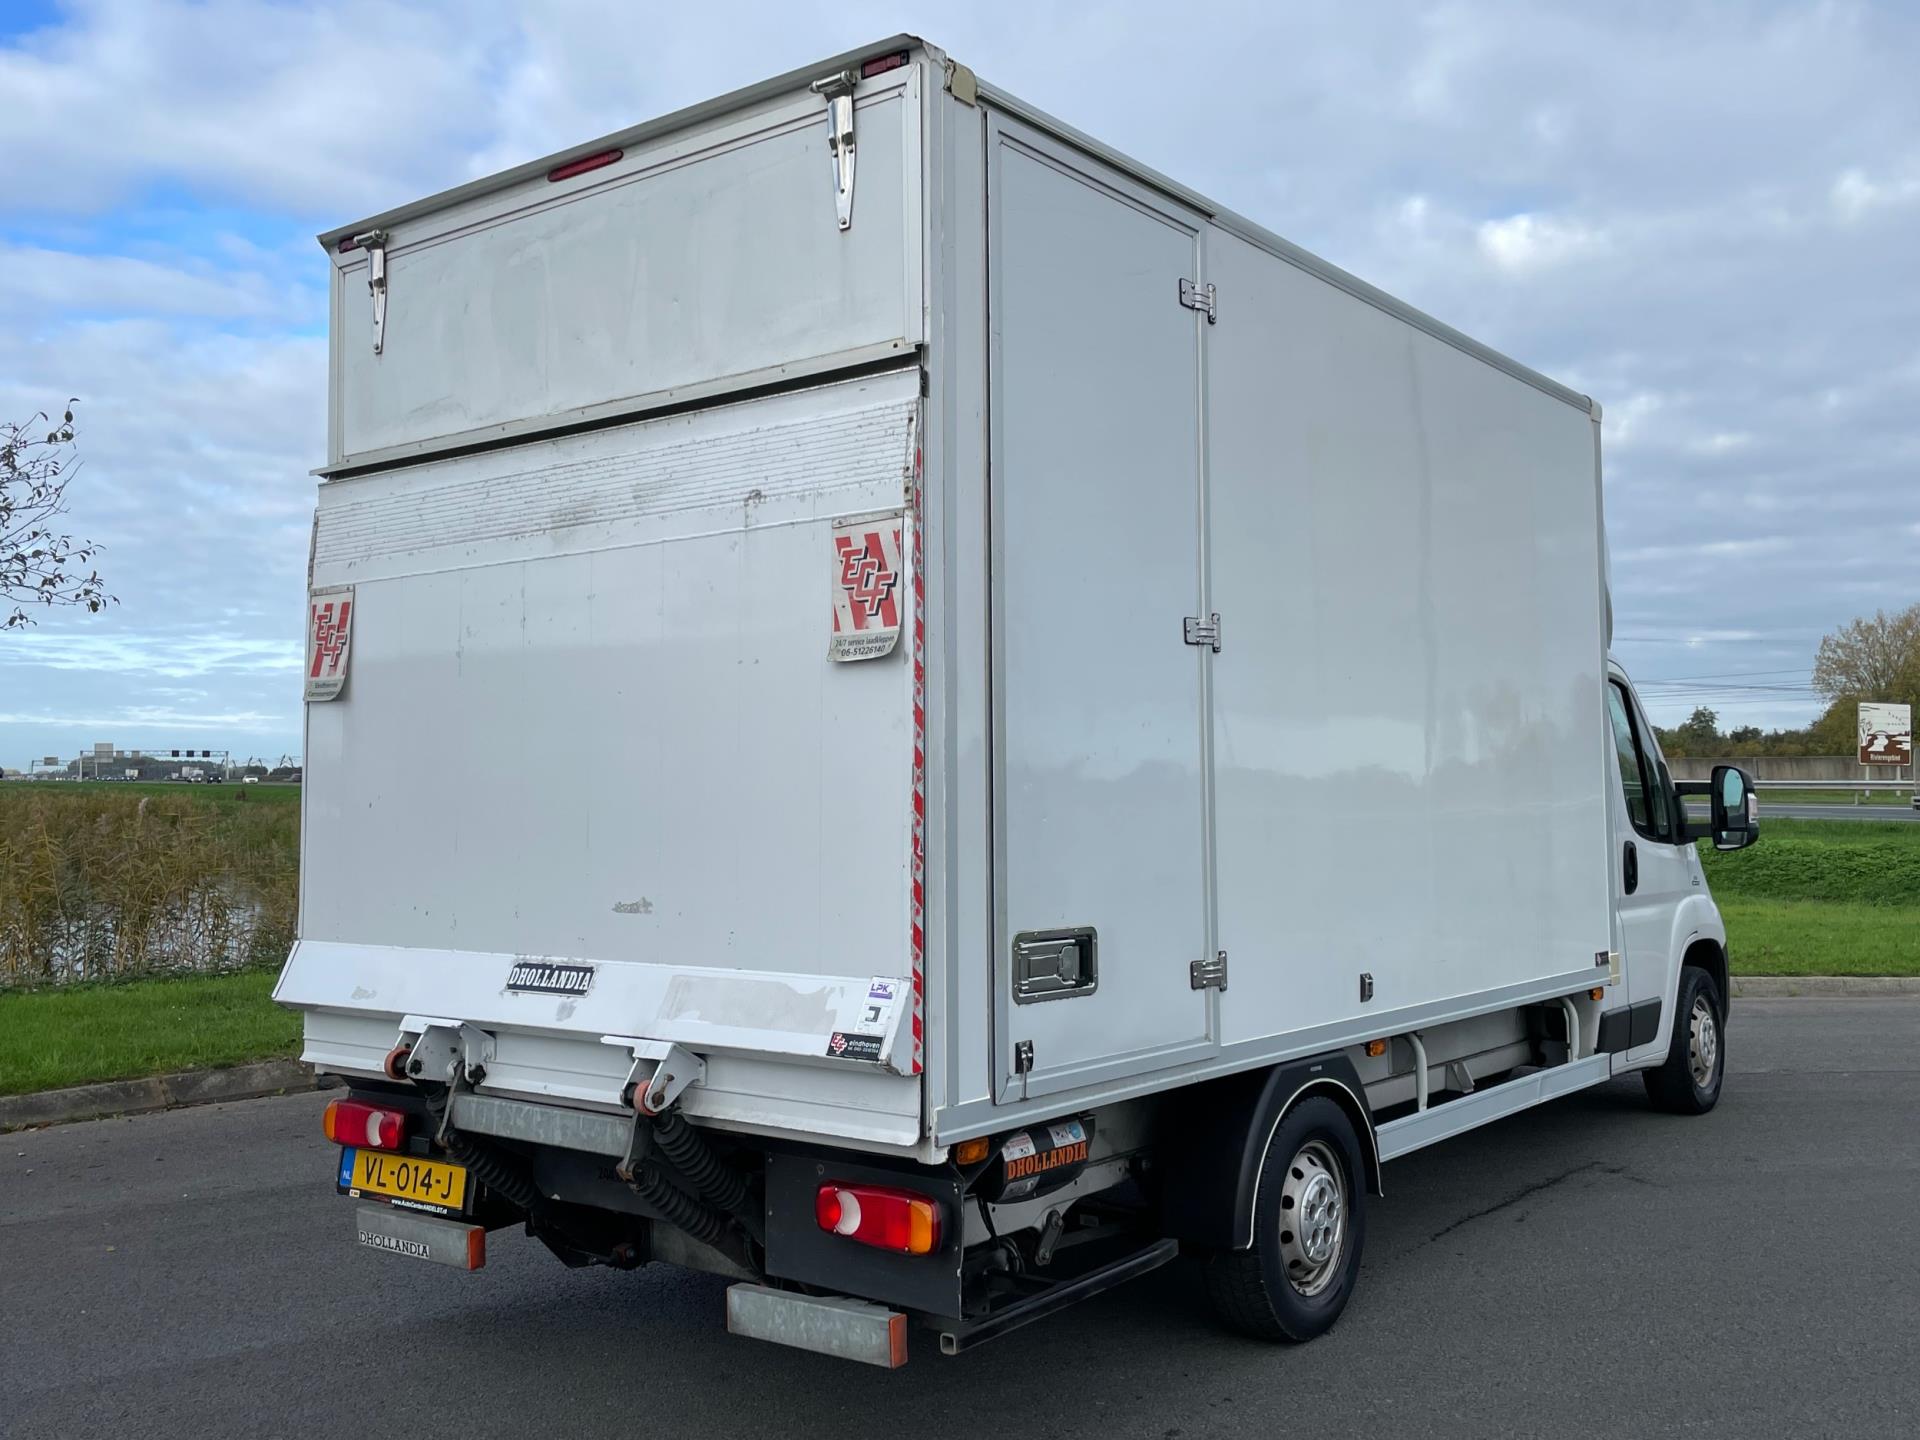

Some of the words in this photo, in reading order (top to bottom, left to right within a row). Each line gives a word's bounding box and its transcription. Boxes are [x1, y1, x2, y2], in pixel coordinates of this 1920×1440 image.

[508, 967, 591, 990] DHOLLANDIA
[870, 983, 890, 993] LPK
[849, 1040, 881, 1049] eindhoven
[1007, 1142, 1088, 1181] DHOLLANDIA
[342, 1169, 351, 1180] NL
[365, 1155, 453, 1200] VL-014-J
[359, 1231, 429, 1258] DHOLLANDIA
